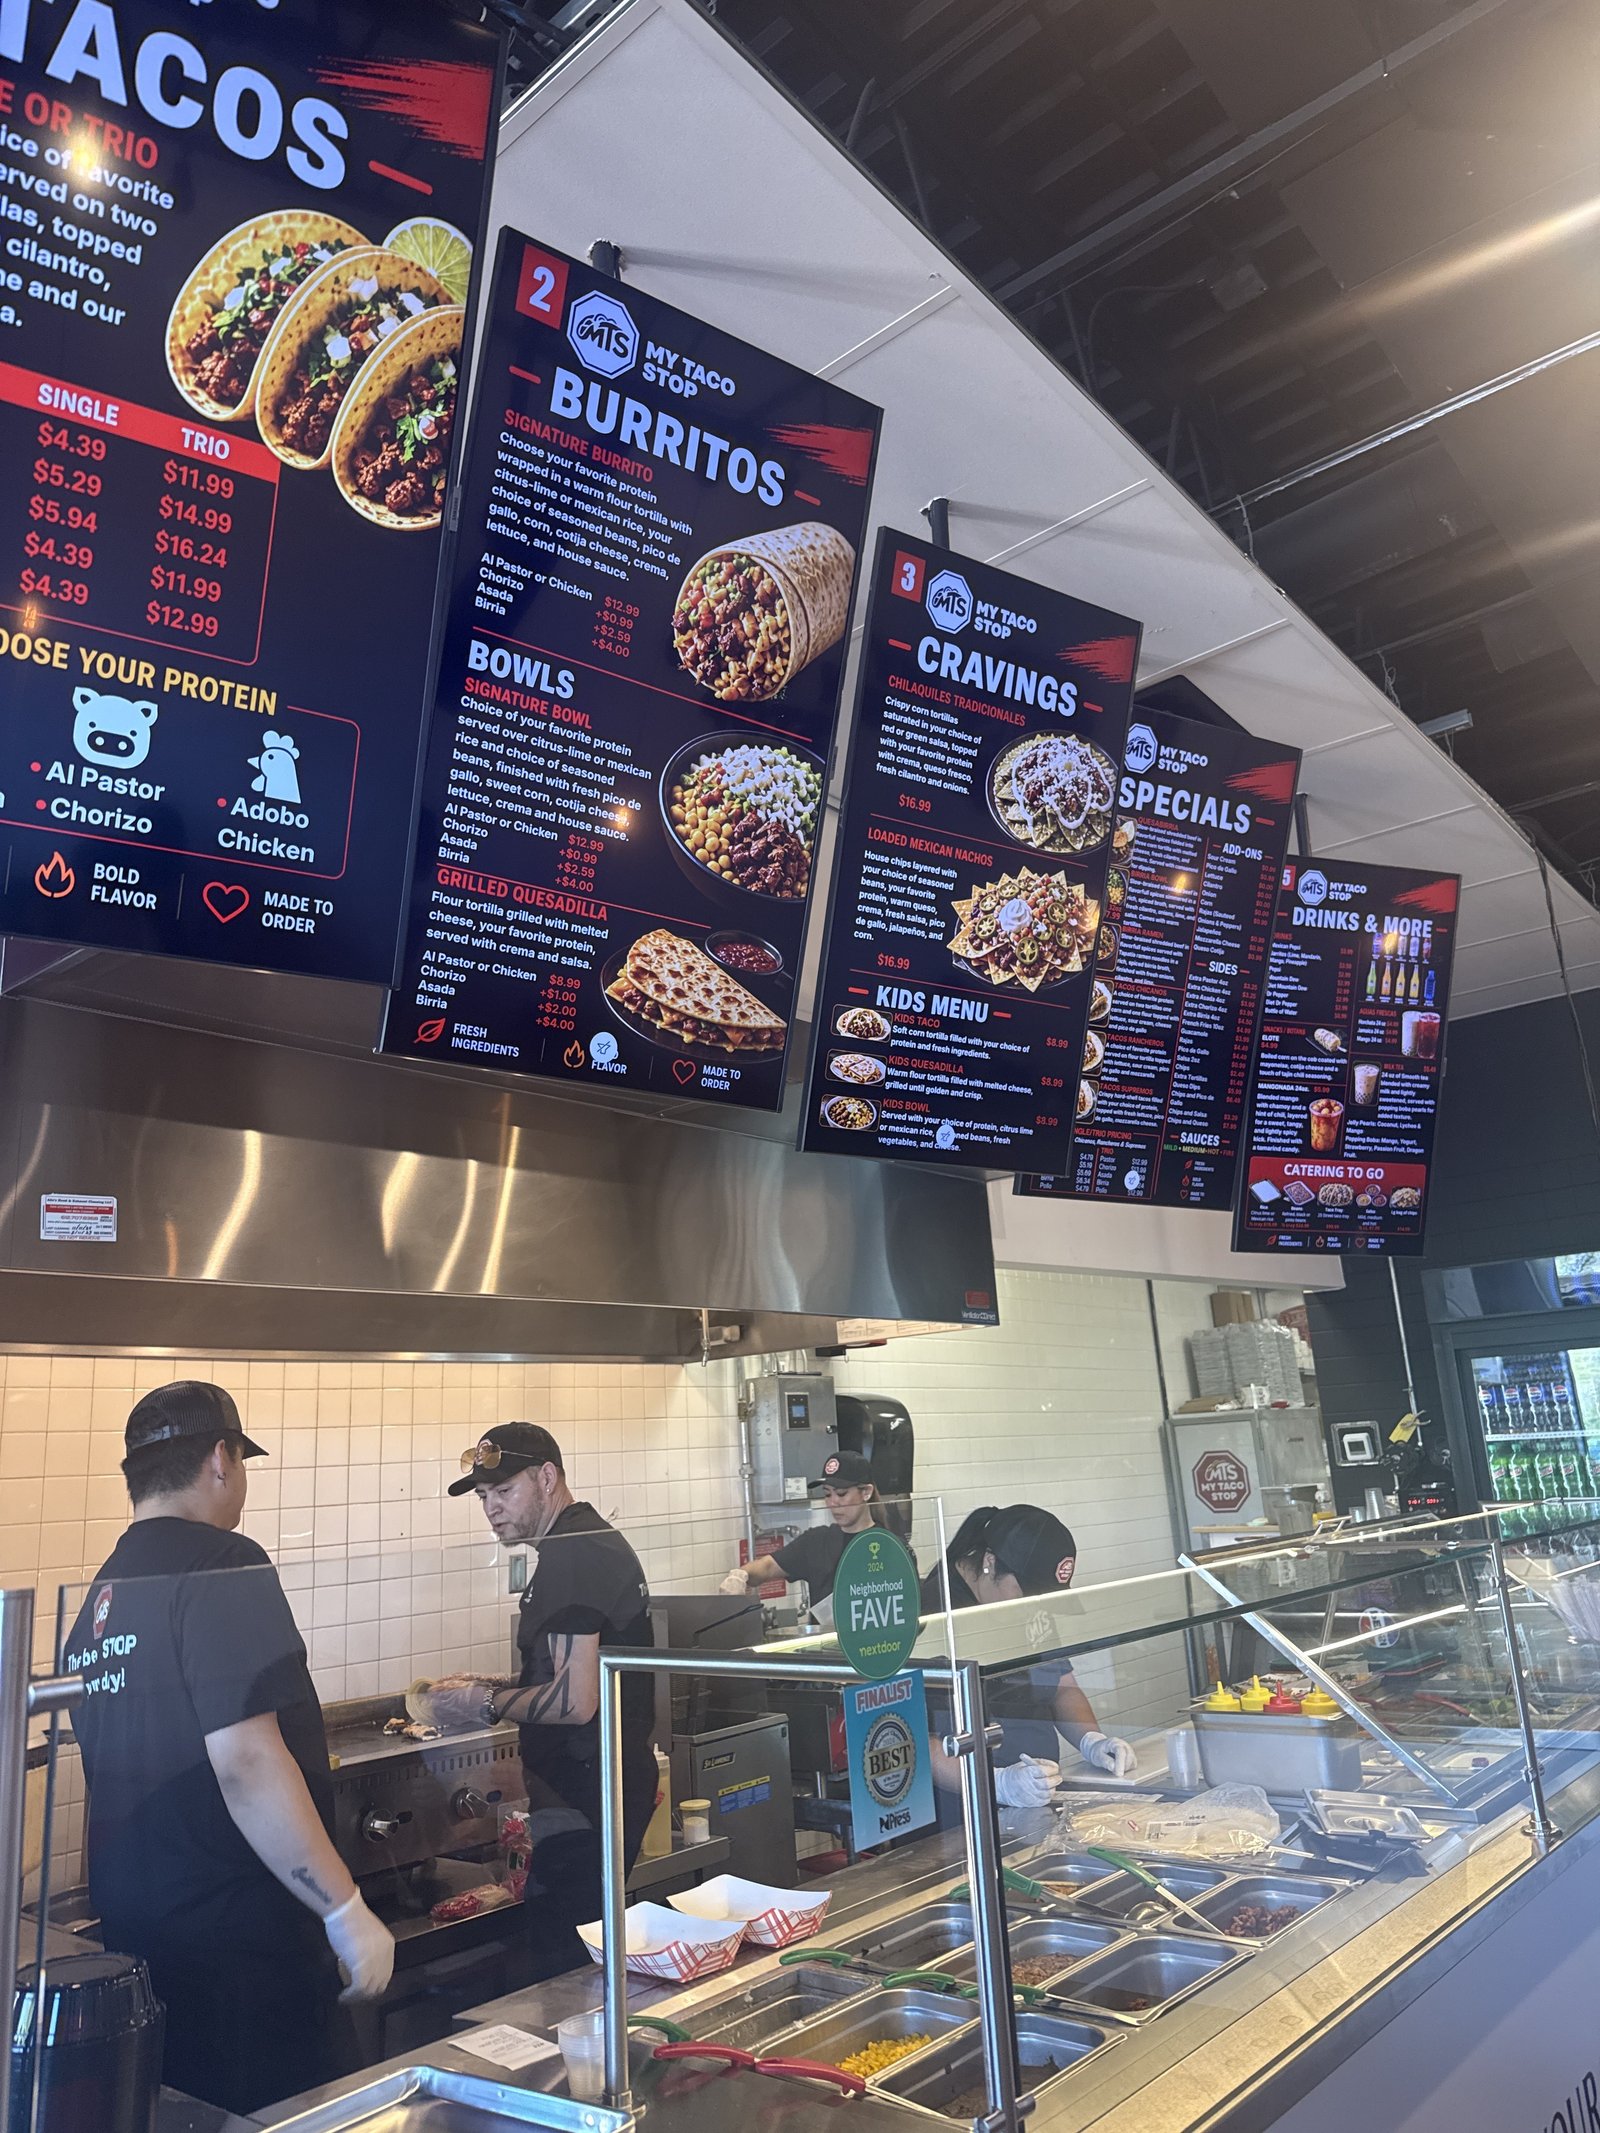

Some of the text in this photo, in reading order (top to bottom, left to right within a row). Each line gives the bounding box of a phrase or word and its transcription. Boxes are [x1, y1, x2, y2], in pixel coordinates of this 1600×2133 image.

[24, 92, 158, 169] OR TRIO
[73, 190, 157, 237] on two
[51, 216, 142, 265] topped
[6, 238, 111, 292] cilantro,
[28, 276, 125, 326] and our
[529, 266, 555, 312] 2
[642, 362, 698, 398] STOP
[645, 341, 735, 396] MY TACO
[38, 383, 230, 460] SINGLE TRIO
[550, 366, 786, 506] BURRITOS
[37, 422, 234, 499] $4.39 $11.99
[505, 409, 653, 483] SIGNATURE BURRITO
[500, 432, 657, 504] Choose your favorite protein
[33, 458, 232, 534] $5.29 $14.99
[494, 468, 672, 545] citrus-lime or mexican rice, your
[497, 450, 692, 536] wrapped in a warm flour tortilla with
[28, 494, 227, 568] $5.94 $16.24
[24, 531, 222, 602] $4.39 $11.99
[901, 562, 915, 592] 3
[19, 568, 218, 638] $4.39 $12.99
[604, 596, 640, 617] $12.99
[976, 600, 1037, 633] MY TACO
[594, 622, 631, 643] +$2.59
[595, 609, 633, 629] +$0.99
[974, 616, 1012, 640] STOP
[592, 636, 630, 657] +$4.00
[79, 648, 277, 715] YOUR PROTEIN
[467, 640, 575, 699] BOWLS
[918, 636, 1077, 717] CRAVINGS
[464, 677, 592, 730] SIGNATURE BOWL
[885, 696, 958, 724] Crispy corn tortillas
[888, 675, 1026, 727] CHILAQUILES TRADICIONALES
[881, 724, 977, 756] red or green salsa, topped
[883, 711, 920, 727] saturated
[921, 720, 928, 729] in
[929, 724, 947, 734] your
[948, 729, 972, 742] choice
[1158, 760, 1187, 774] STOP
[1160, 746, 1208, 767] MY TACO
[80, 767, 165, 802] Pastor
[50, 797, 153, 834] Chorizo
[231, 796, 309, 829] Adobo
[899, 795, 931, 813] $16.99
[1119, 777, 1251, 834] SPECIALS
[217, 828, 315, 863] Chicken
[868, 827, 993, 867] LOADED MEXICAN NACHOS
[1223, 843, 1262, 861] ADD-ONS
[94, 863, 140, 885] BOLD
[1282, 869, 1291, 886] 5
[1329, 882, 1367, 894] MY TACO
[91, 885, 157, 910] FLAVOR
[264, 891, 334, 916] MADE TO
[437, 868, 608, 922] GRILLED QUESADILLA
[1329, 892, 1351, 901] STOP
[261, 912, 316, 933] ORDER
[1293, 906, 1433, 938] DRINKS & MORE
[877, 953, 910, 970] $16.99
[1209, 961, 1238, 976] SIDES
[540, 988, 577, 1003] +$1.00
[549, 974, 581, 989] $8.99
[537, 1002, 576, 1017] +$2.00
[876, 986, 989, 1023] KIDS MENU
[453, 1023, 488, 1038] FRESH
[536, 1017, 574, 1031] +$4.00
[894, 1013, 940, 1028] KIDS TACO
[451, 1036, 519, 1058] INGREDIENTS
[591, 1060, 627, 1075] FLAVOR
[702, 1065, 741, 1080] MADE TO
[889, 1055, 964, 1074] KIDS QUESADILLA
[701, 1078, 730, 1091] ORDER
[883, 1099, 930, 1112] KIDS BOWL
[1180, 1132, 1220, 1146] SAUCES
[1284, 1164, 1384, 1179] CATERING TO GO
[1201, 1482, 1244, 1491] MY TACO
[1212, 1492, 1237, 1501] STOP
[868, 1562, 884, 1572] 2024
[850, 1579, 903, 1597] Neighborhood
[851, 1595, 906, 1632] FAVE
[103, 1635, 137, 1659] STOP
[859, 1641, 901, 1658] nextdoor
[856, 1678, 913, 1714] FINALIST
[869, 1744, 910, 1776] BEST
